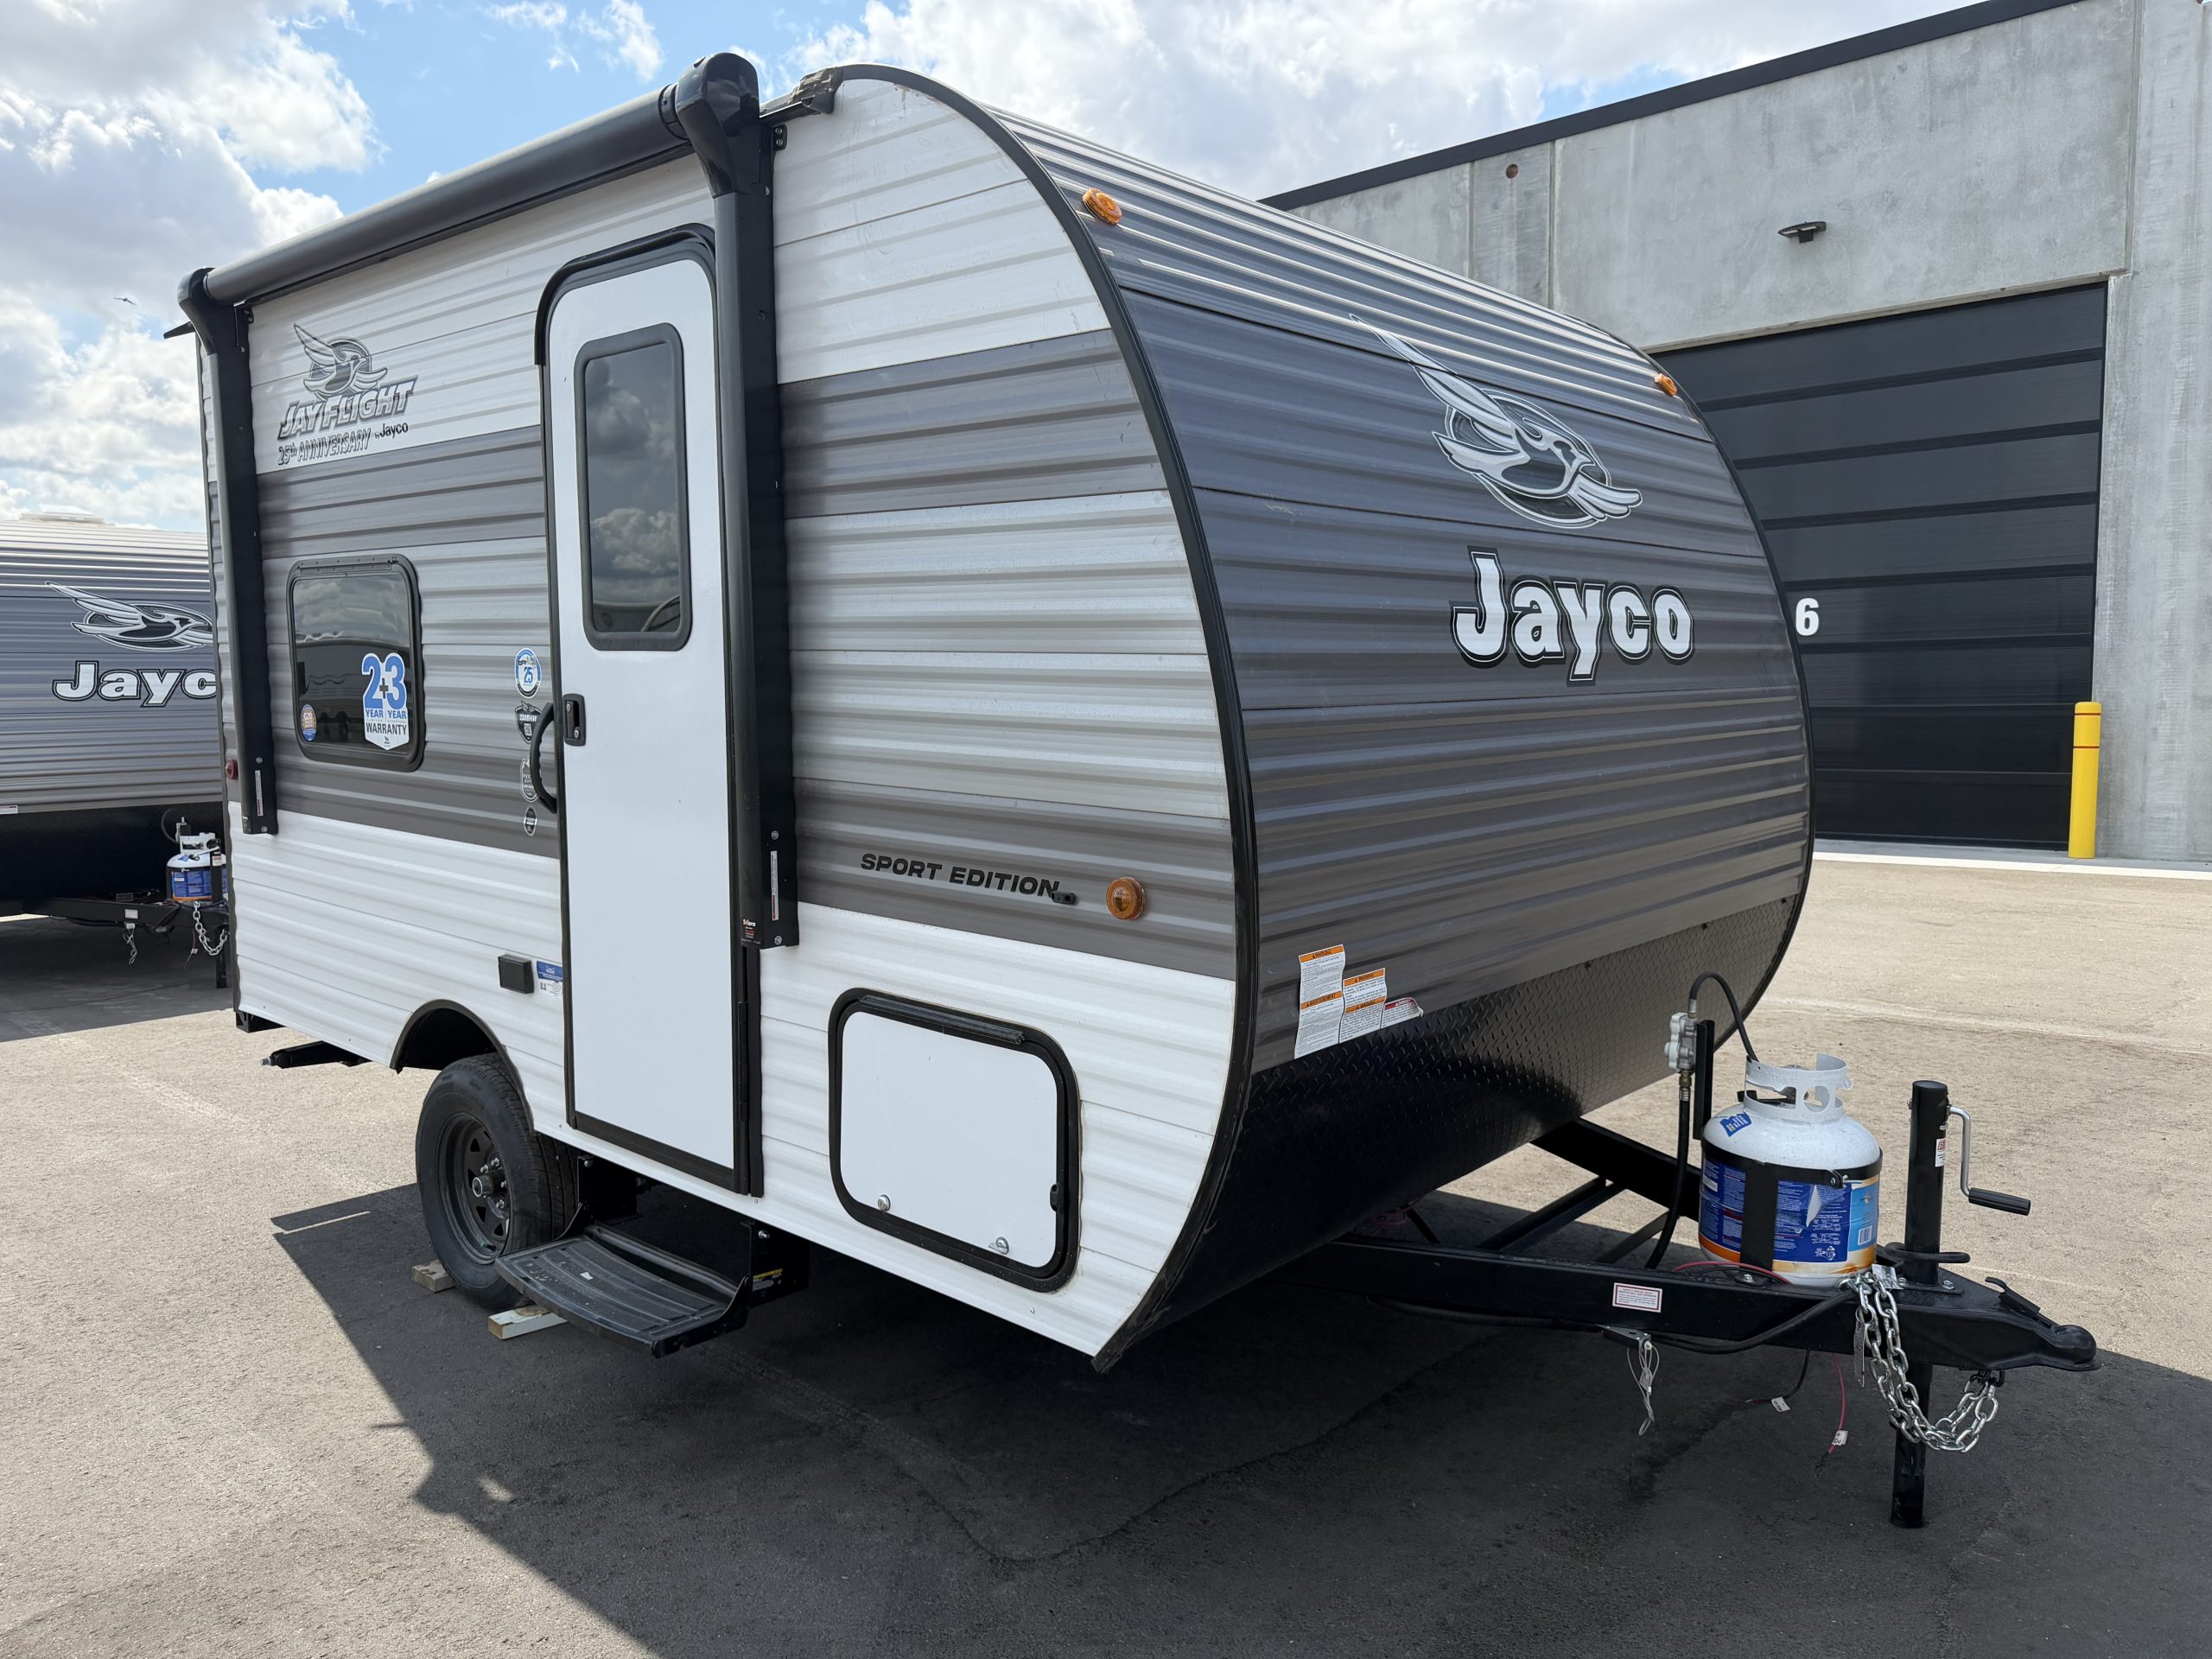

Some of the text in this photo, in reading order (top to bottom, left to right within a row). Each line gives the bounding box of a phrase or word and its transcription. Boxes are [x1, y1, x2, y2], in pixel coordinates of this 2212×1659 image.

[277, 376, 418, 440] JAY FLIGHT
[297, 428, 372, 461] ANNIVERSARY
[380, 422, 409, 438] Jayco
[1446, 546, 1695, 685] Jayco
[1796, 597, 1820, 636] 6
[52, 660, 217, 708] Jayc
[365, 709, 407, 720] YEAR YEAR
[365, 722, 407, 735] WARRANTY
[861, 853, 1060, 899] SPORT EDITION
